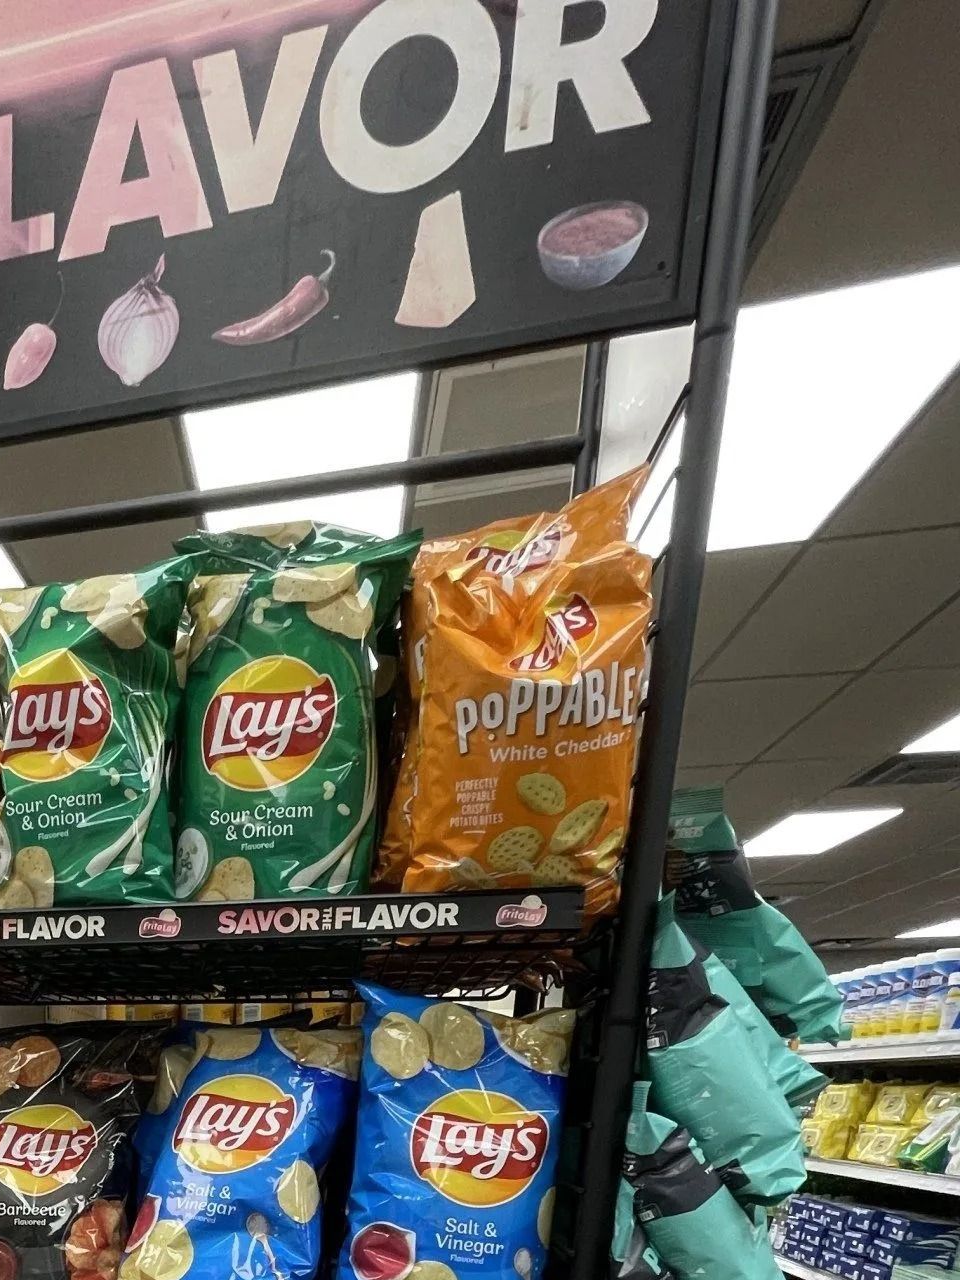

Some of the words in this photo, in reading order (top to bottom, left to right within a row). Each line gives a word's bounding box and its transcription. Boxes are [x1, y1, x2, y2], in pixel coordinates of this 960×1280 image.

[2, 680, 103, 753] Lay's
[208, 686, 329, 761] Lay's
[490, 745, 548, 763] White
[554, 731, 625, 757] Cheddar
[455, 777, 499, 793] PERFECTLY
[456, 789, 497, 804] POPPABLE
[6, 800, 43, 817] Sour
[47, 791, 103, 810] Cream
[209, 809, 250, 826] Sour
[253, 804, 314, 822] Cream
[461, 802, 491, 816] CRISPY
[21, 816, 34, 832] &
[38, 809, 86, 829] Onion
[225, 825, 238, 841] &
[242, 821, 294, 840] Onion
[2, 915, 105, 941] FLAVOR
[218, 907, 320, 936] SAVOR
[335, 902, 459, 931] FLAVOR
[177, 1095, 289, 1151] Lay's
[420, 1115, 542, 1180] Lay's
[186, 1183, 216, 1198] Salt
[219, 1186, 232, 1199] &
[176, 1197, 237, 1220] Vinegar
[13, 1217, 47, 1227] Flavored
[445, 1217, 480, 1234] Salt
[484, 1222, 498, 1238] &
[436, 1233, 505, 1257] Vinegar
